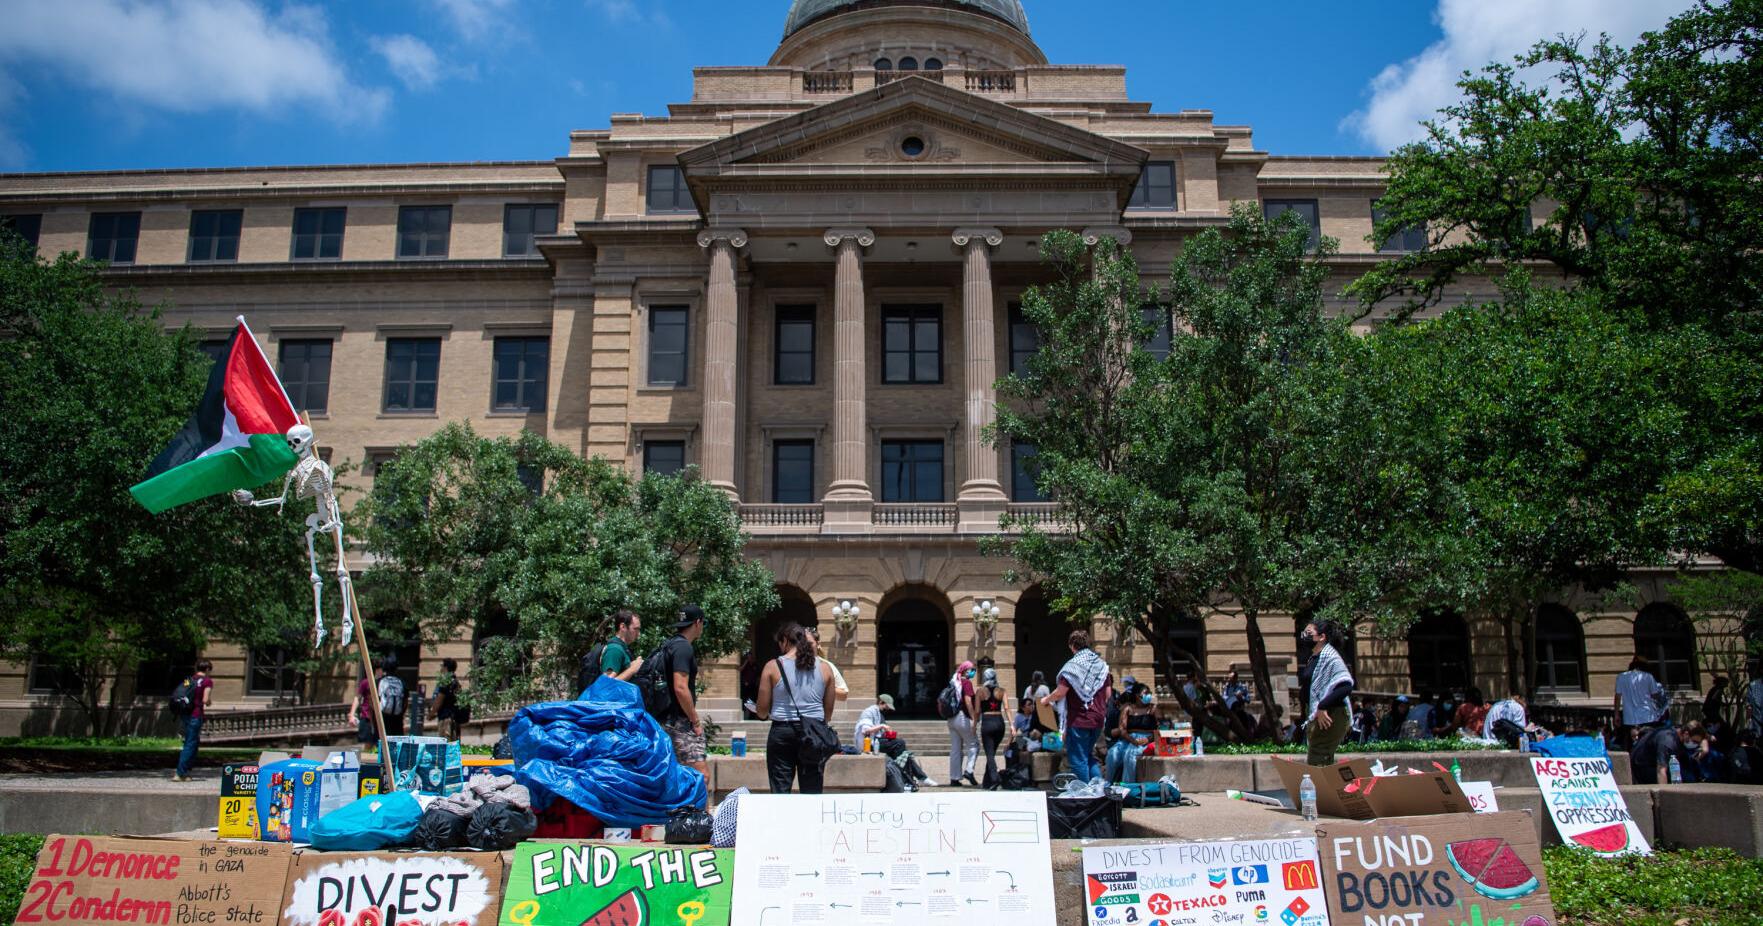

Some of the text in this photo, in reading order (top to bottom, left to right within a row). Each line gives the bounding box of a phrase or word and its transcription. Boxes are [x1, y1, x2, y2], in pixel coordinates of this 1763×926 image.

[1536, 760, 1609, 778] AGS STAND
[1551, 777, 1600, 788] AGAINST
[225, 800, 240, 814] 20
[821, 800, 904, 828] History
[1556, 806, 1632, 824] OPPRESSION
[199, 843, 269, 857] the genocide
[1103, 839, 1305, 869] DIVEST FROM GENOCIDE
[1334, 834, 1434, 871] FUND
[199, 859, 244, 874] in GAZA
[532, 845, 619, 895] END
[630, 849, 723, 890] THE
[178, 881, 231, 902] Abbott's
[317, 873, 470, 914] DIVEST
[1109, 883, 1137, 892] ISRAELI
[1236, 890, 1266, 902] PUMA
[1336, 869, 1455, 913] BOOKS
[1100, 895, 1131, 905] GOODS
[1172, 894, 1227, 911] TEXACO
[176, 903, 216, 925] Police
